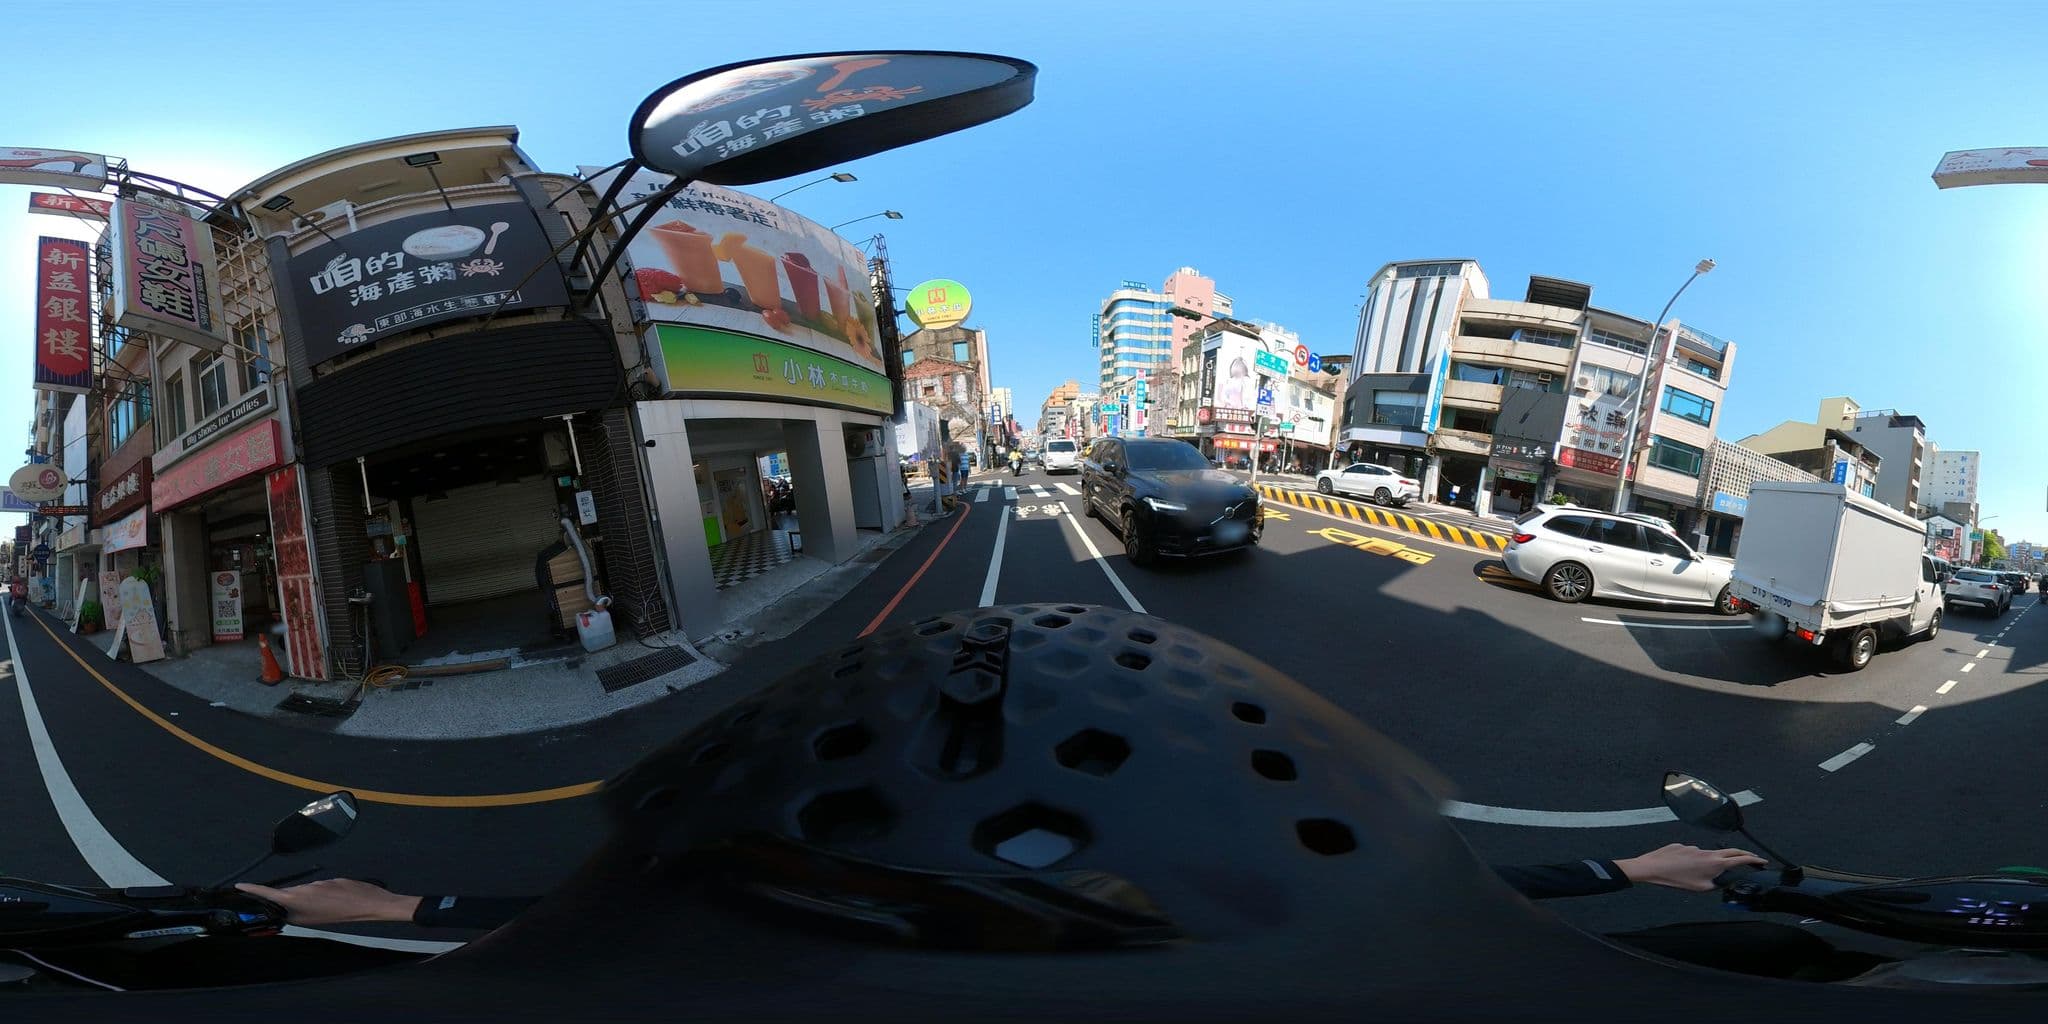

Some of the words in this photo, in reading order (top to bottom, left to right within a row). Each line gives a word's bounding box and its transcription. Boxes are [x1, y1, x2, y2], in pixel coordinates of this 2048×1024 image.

[672, 105, 793, 157] 咱的
[716, 103, 865, 158] 海產粥
[631, 192, 780, 230] 鮮帶著走!
[133, 205, 196, 322] 大尺碼女鞋
[309, 251, 405, 295] 咱的
[349, 263, 457, 307] 海產粥
[43, 247, 88, 361] 新益銀樓
[232, 398, 260, 419] Ladies
[1260, 389, 1268, 400] P
